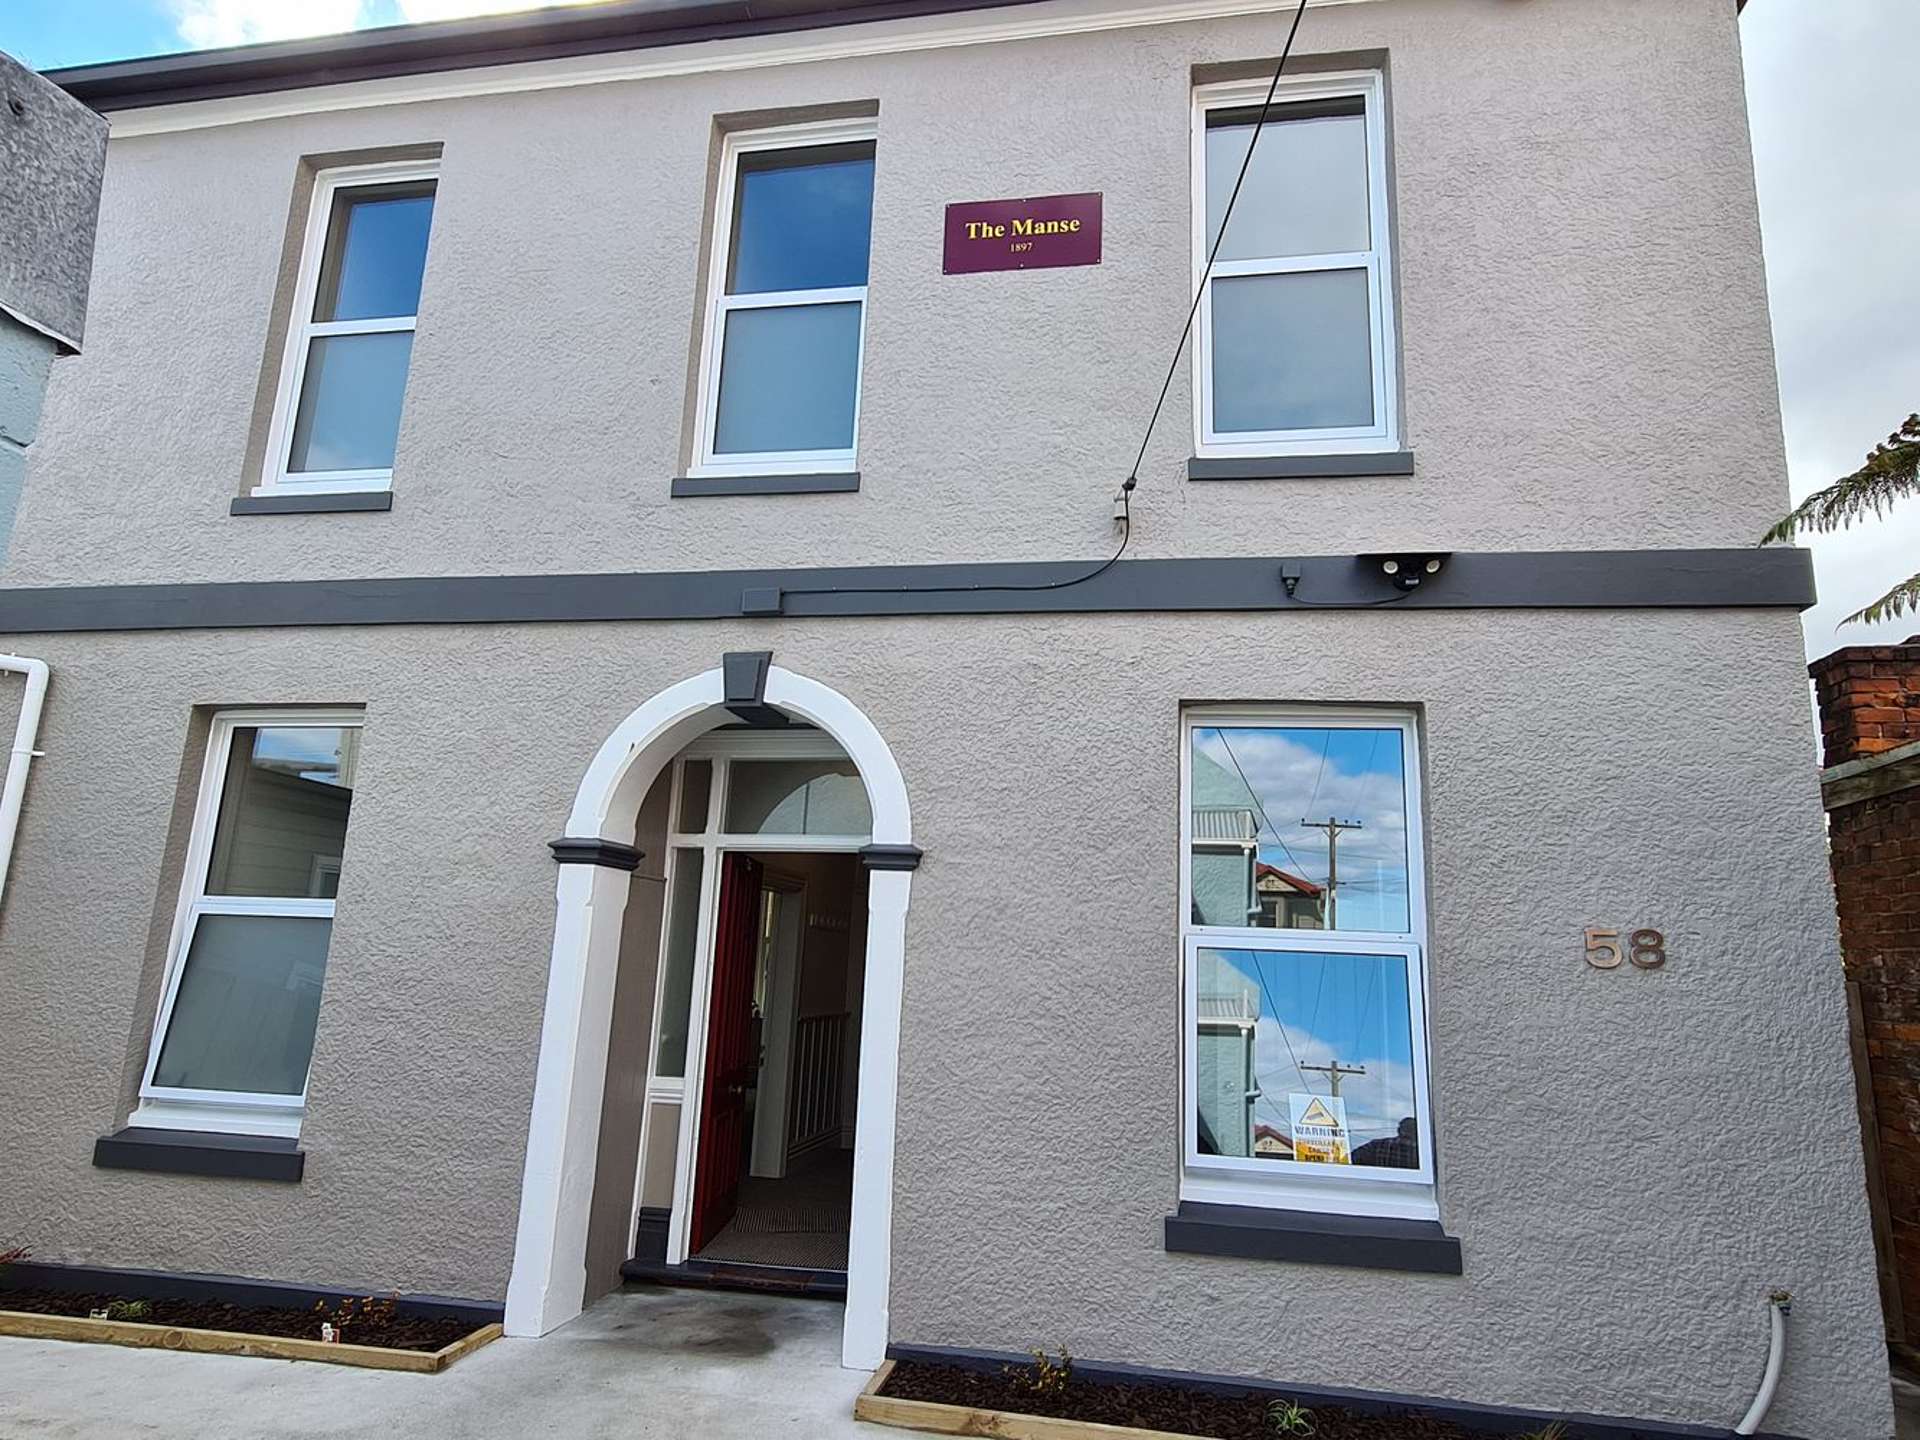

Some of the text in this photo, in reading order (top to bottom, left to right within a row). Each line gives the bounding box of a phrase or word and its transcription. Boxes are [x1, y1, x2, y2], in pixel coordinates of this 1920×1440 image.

[965, 218, 1081, 239] The Manse
[1010, 242, 1033, 252] 1897
[1584, 929, 1665, 969] 58
[1294, 1125, 1346, 1138] WARNING
